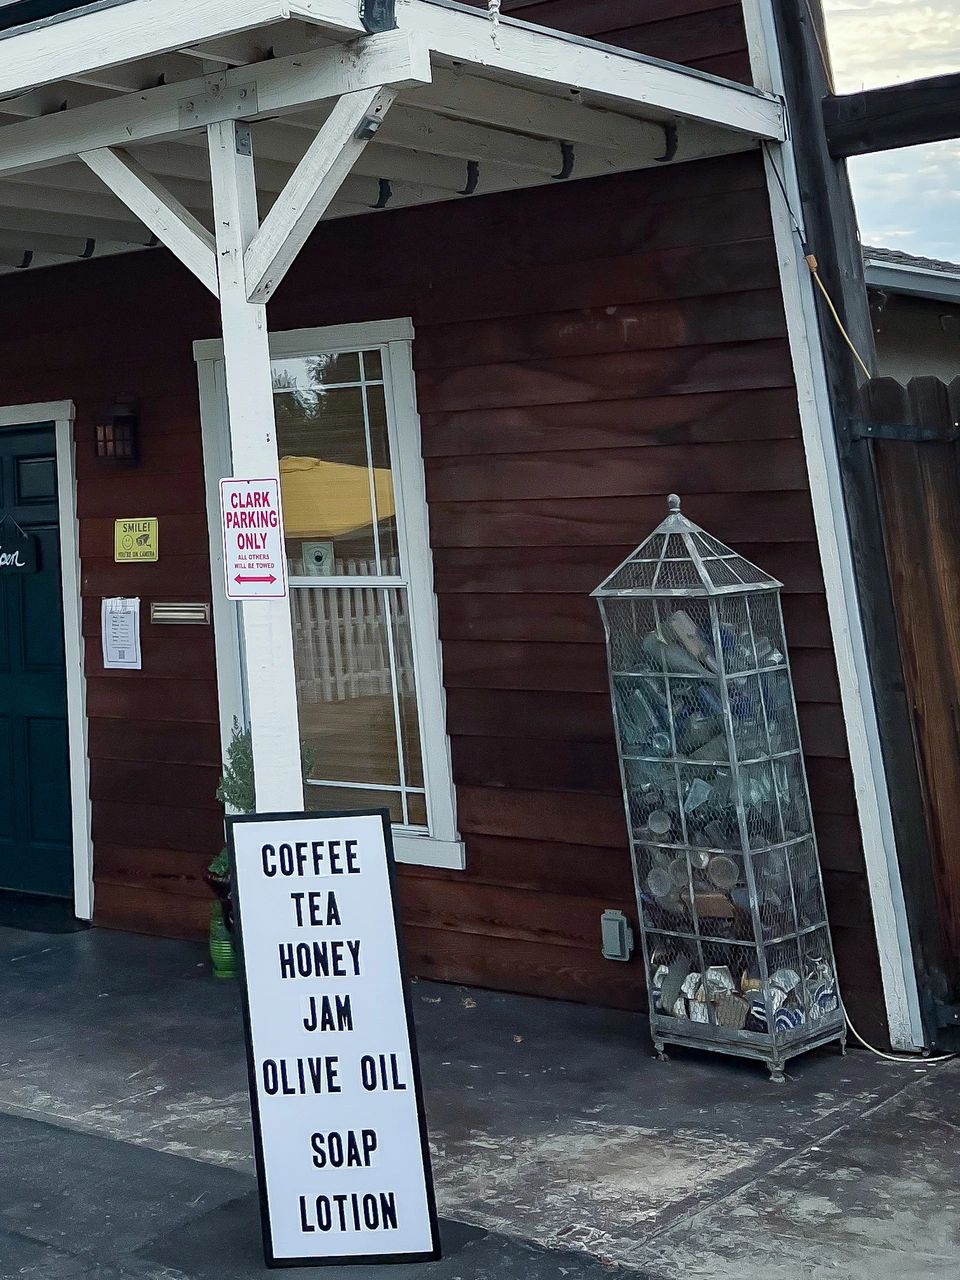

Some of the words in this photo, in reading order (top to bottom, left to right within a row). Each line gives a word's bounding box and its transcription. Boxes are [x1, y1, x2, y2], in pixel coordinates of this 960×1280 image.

[230, 491, 270, 508] CLARK
[122, 522, 150, 532] SMILE!
[226, 510, 277, 529] PARKING
[237, 532, 267, 550] ONLY
[261, 839, 360, 877] COFFEE
[291, 891, 341, 927] TEA
[278, 940, 361, 979] HONEY
[303, 994, 353, 1032] JAM
[262, 1056, 341, 1095] OLIVE
[360, 1053, 406, 1091] OIL
[311, 1129, 377, 1168] SOAP
[299, 1192, 398, 1232] LOTION
